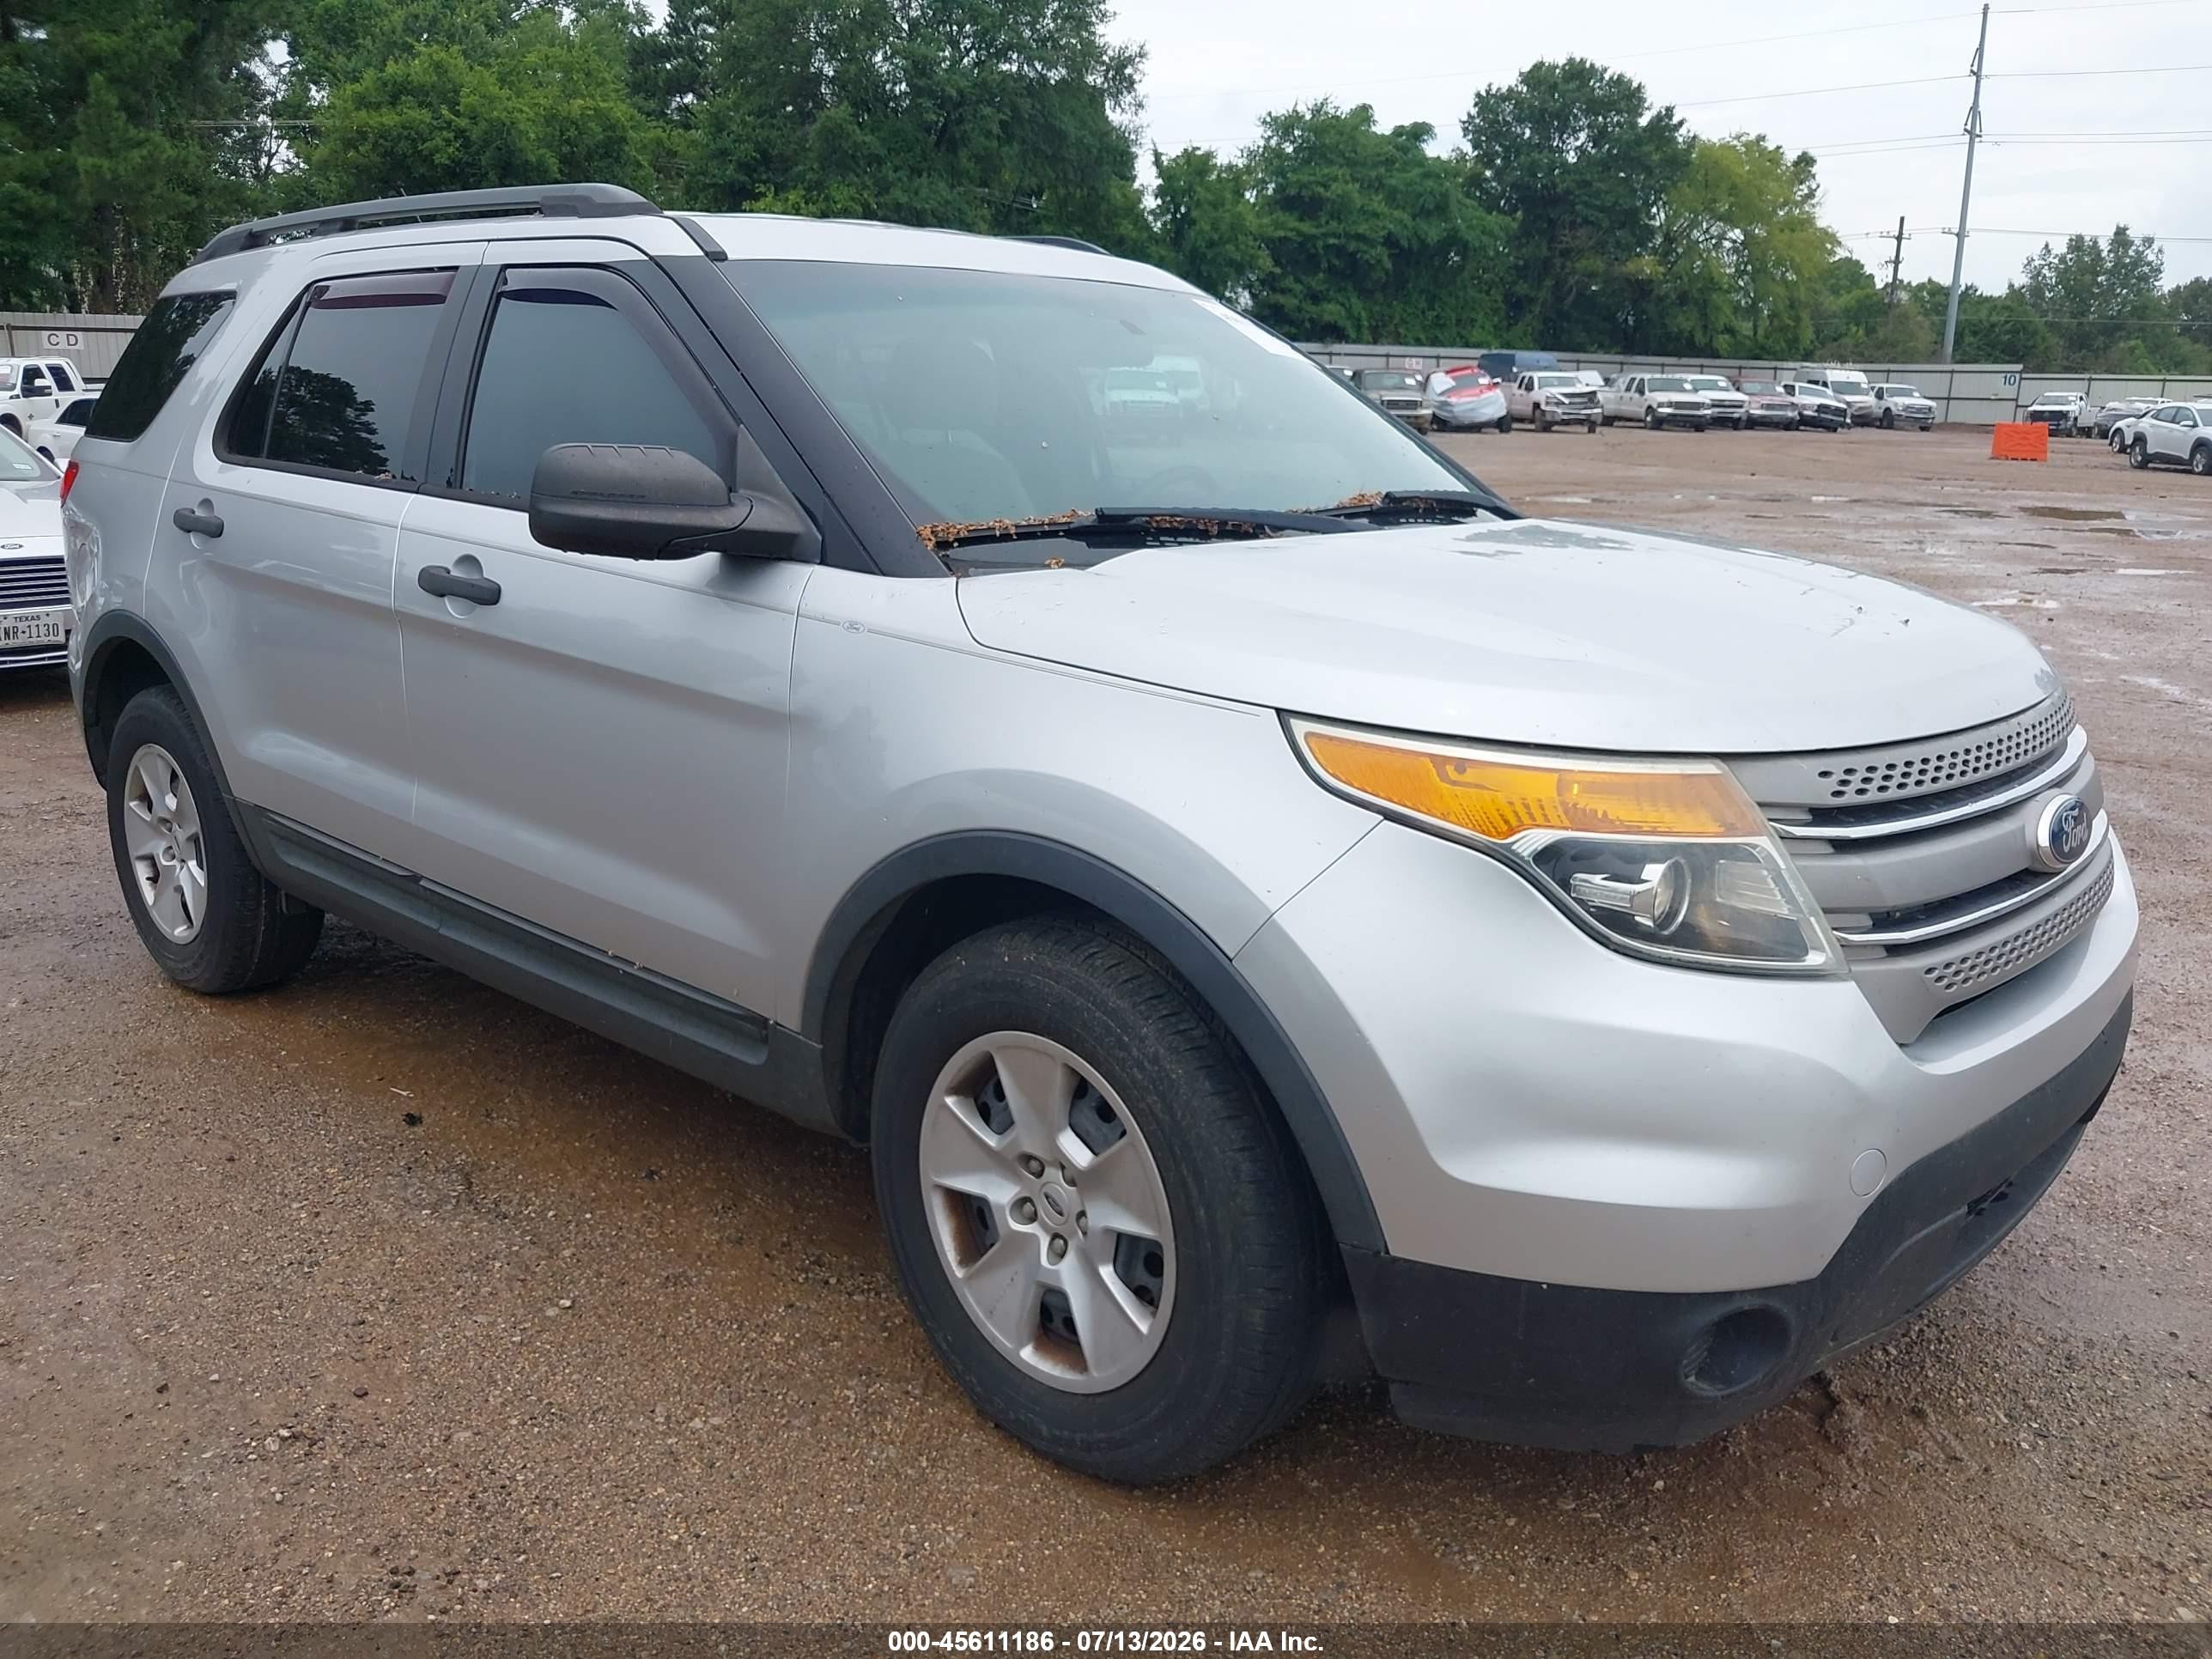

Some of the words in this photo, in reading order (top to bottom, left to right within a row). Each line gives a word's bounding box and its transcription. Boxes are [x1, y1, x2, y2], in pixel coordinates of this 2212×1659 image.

[47, 333, 60, 346] C
[66, 333, 78, 346] D
[2002, 374, 2017, 386] 10
[2062, 807, 2088, 853] Ford
